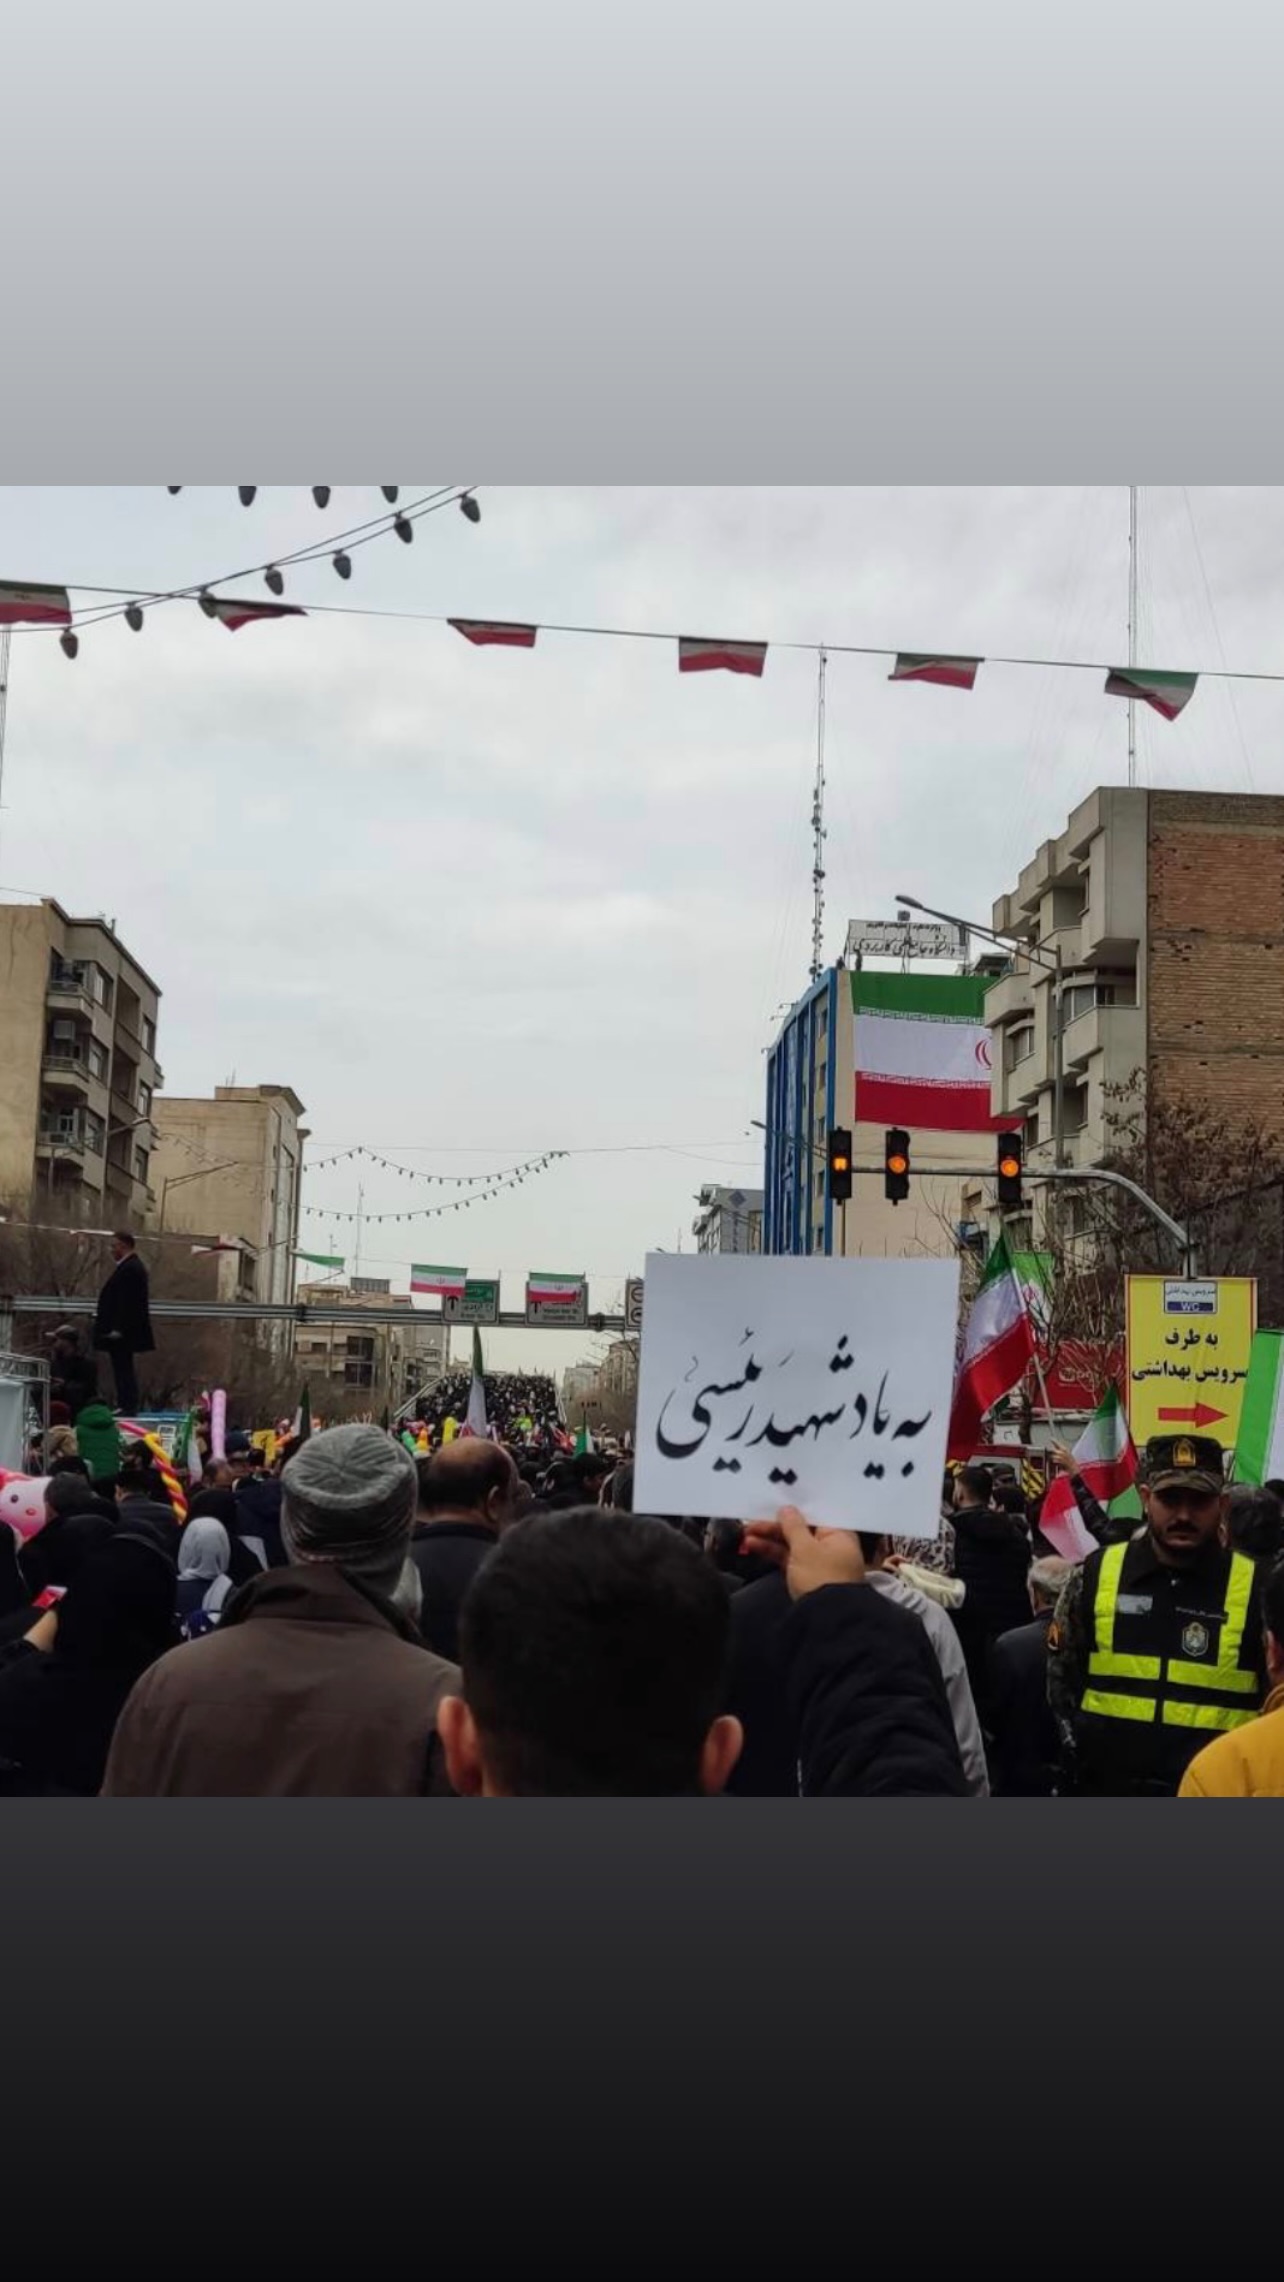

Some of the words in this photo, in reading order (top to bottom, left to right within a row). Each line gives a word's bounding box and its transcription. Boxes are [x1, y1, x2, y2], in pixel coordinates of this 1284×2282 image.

[1180, 1302, 1200, 1311] WC
[1164, 1328, 1201, 1351] طرف
[1205, 1333, 1219, 1350] به
[1132, 1360, 1191, 1382] بهداشتی
[746, 1335, 855, 1485] شهید
[850, 1369, 890, 1480] یاد
[891, 1408, 932, 1478] به
